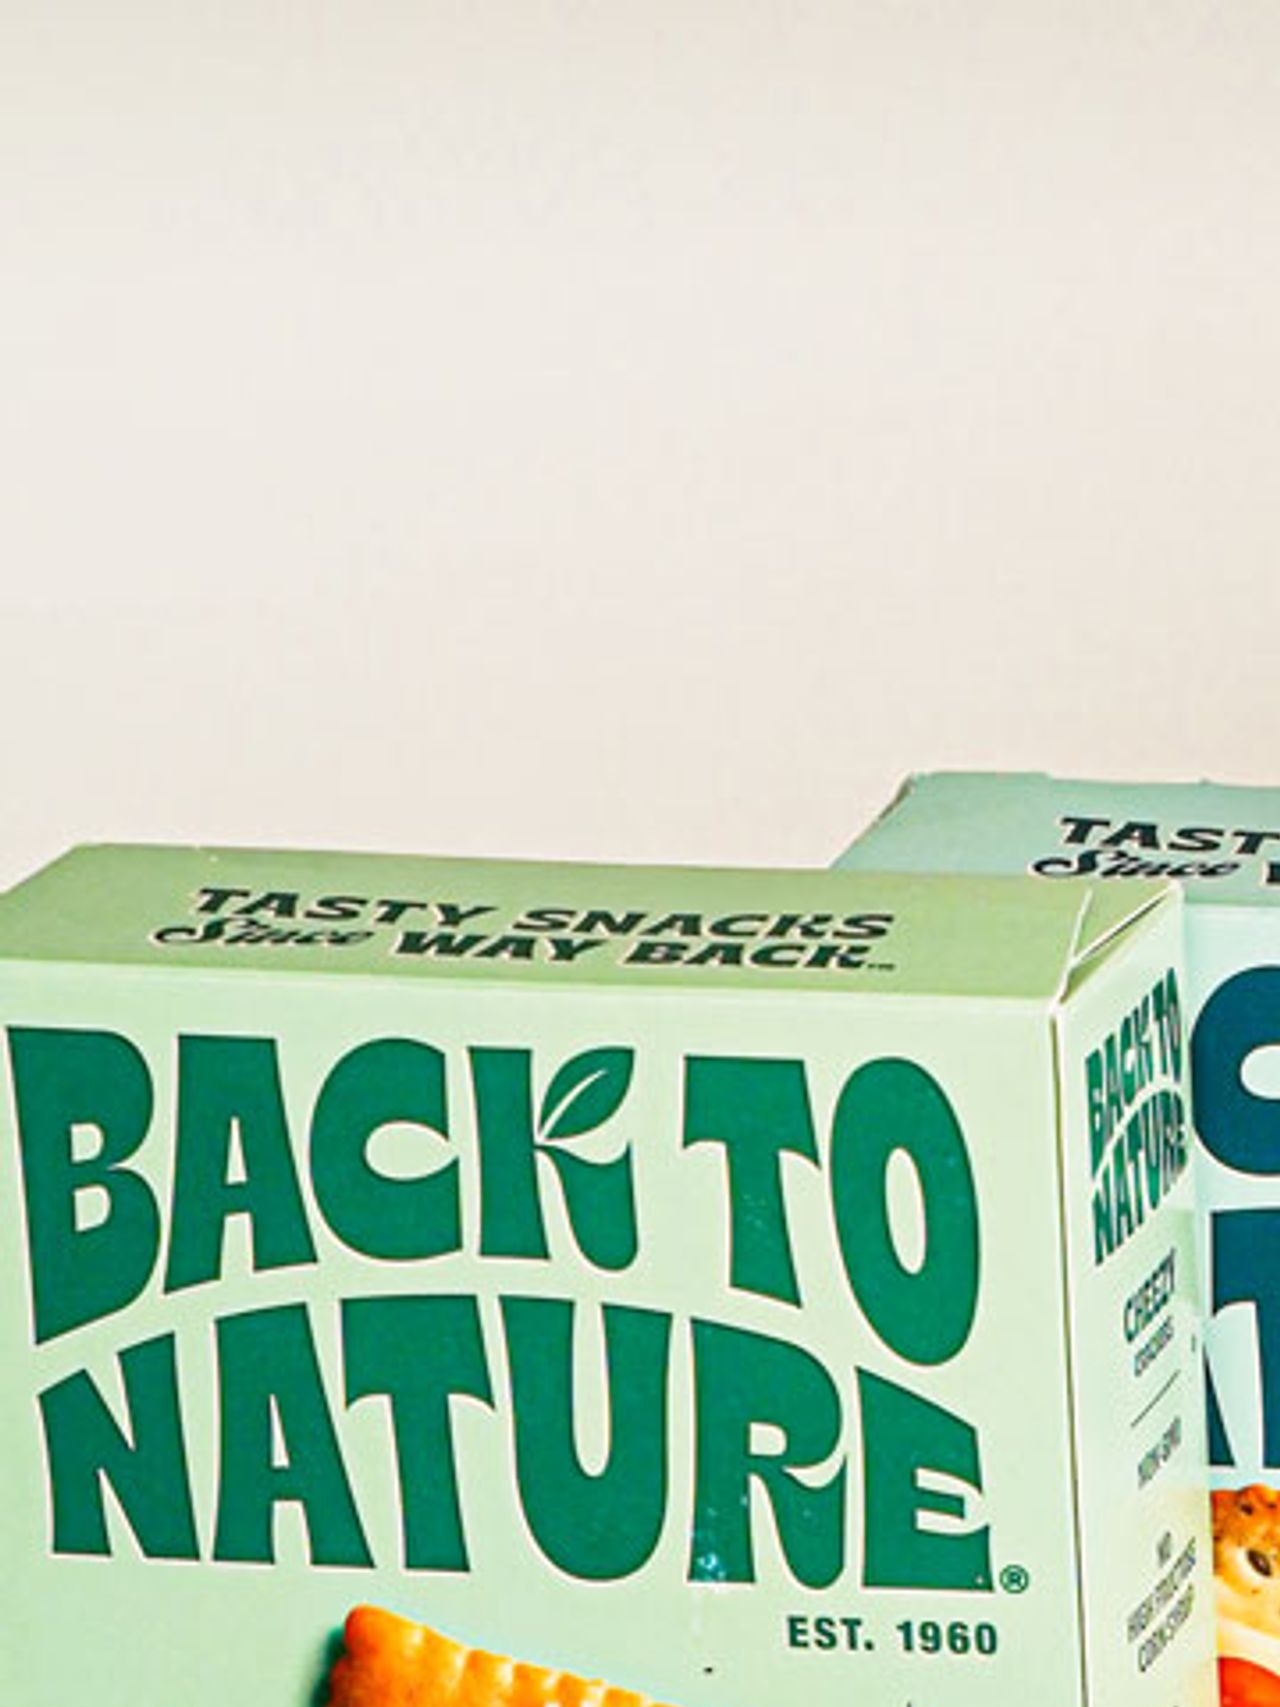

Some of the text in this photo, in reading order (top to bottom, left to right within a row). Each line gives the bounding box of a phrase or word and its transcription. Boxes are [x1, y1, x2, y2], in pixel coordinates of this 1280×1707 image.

[1030, 846, 1243, 881] Since
[154, 917, 374, 948] Since
[395, 930, 598, 962] WAY
[196, 888, 895, 940] TASTY SNACKS
[1085, 966, 1182, 1181] BACK TO
[5, 1025, 980, 1365] BACK TO
[1092, 1089, 1188, 1265] NATURE
[787, 1613, 999, 1658] EST. 1960
